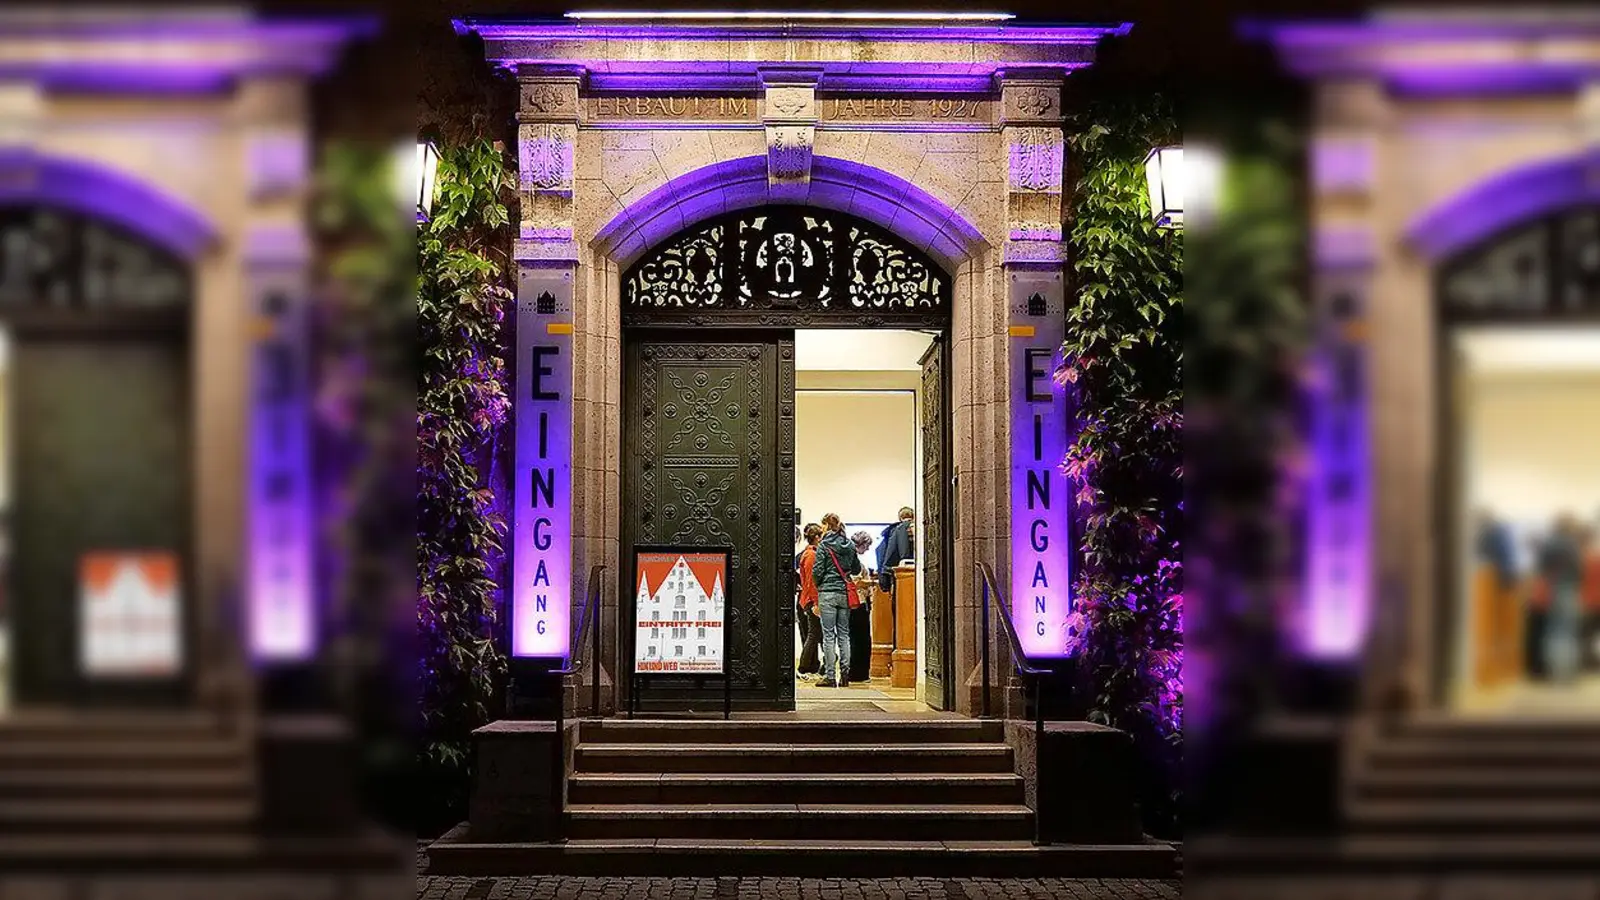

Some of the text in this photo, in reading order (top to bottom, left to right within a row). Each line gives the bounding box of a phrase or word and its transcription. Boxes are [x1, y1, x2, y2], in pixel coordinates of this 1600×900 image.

[597, 97, 982, 120] ERBAUT IM JAHRE 1927
[531, 345, 560, 636] EINGANG
[1024, 347, 1053, 637] EINGANG
